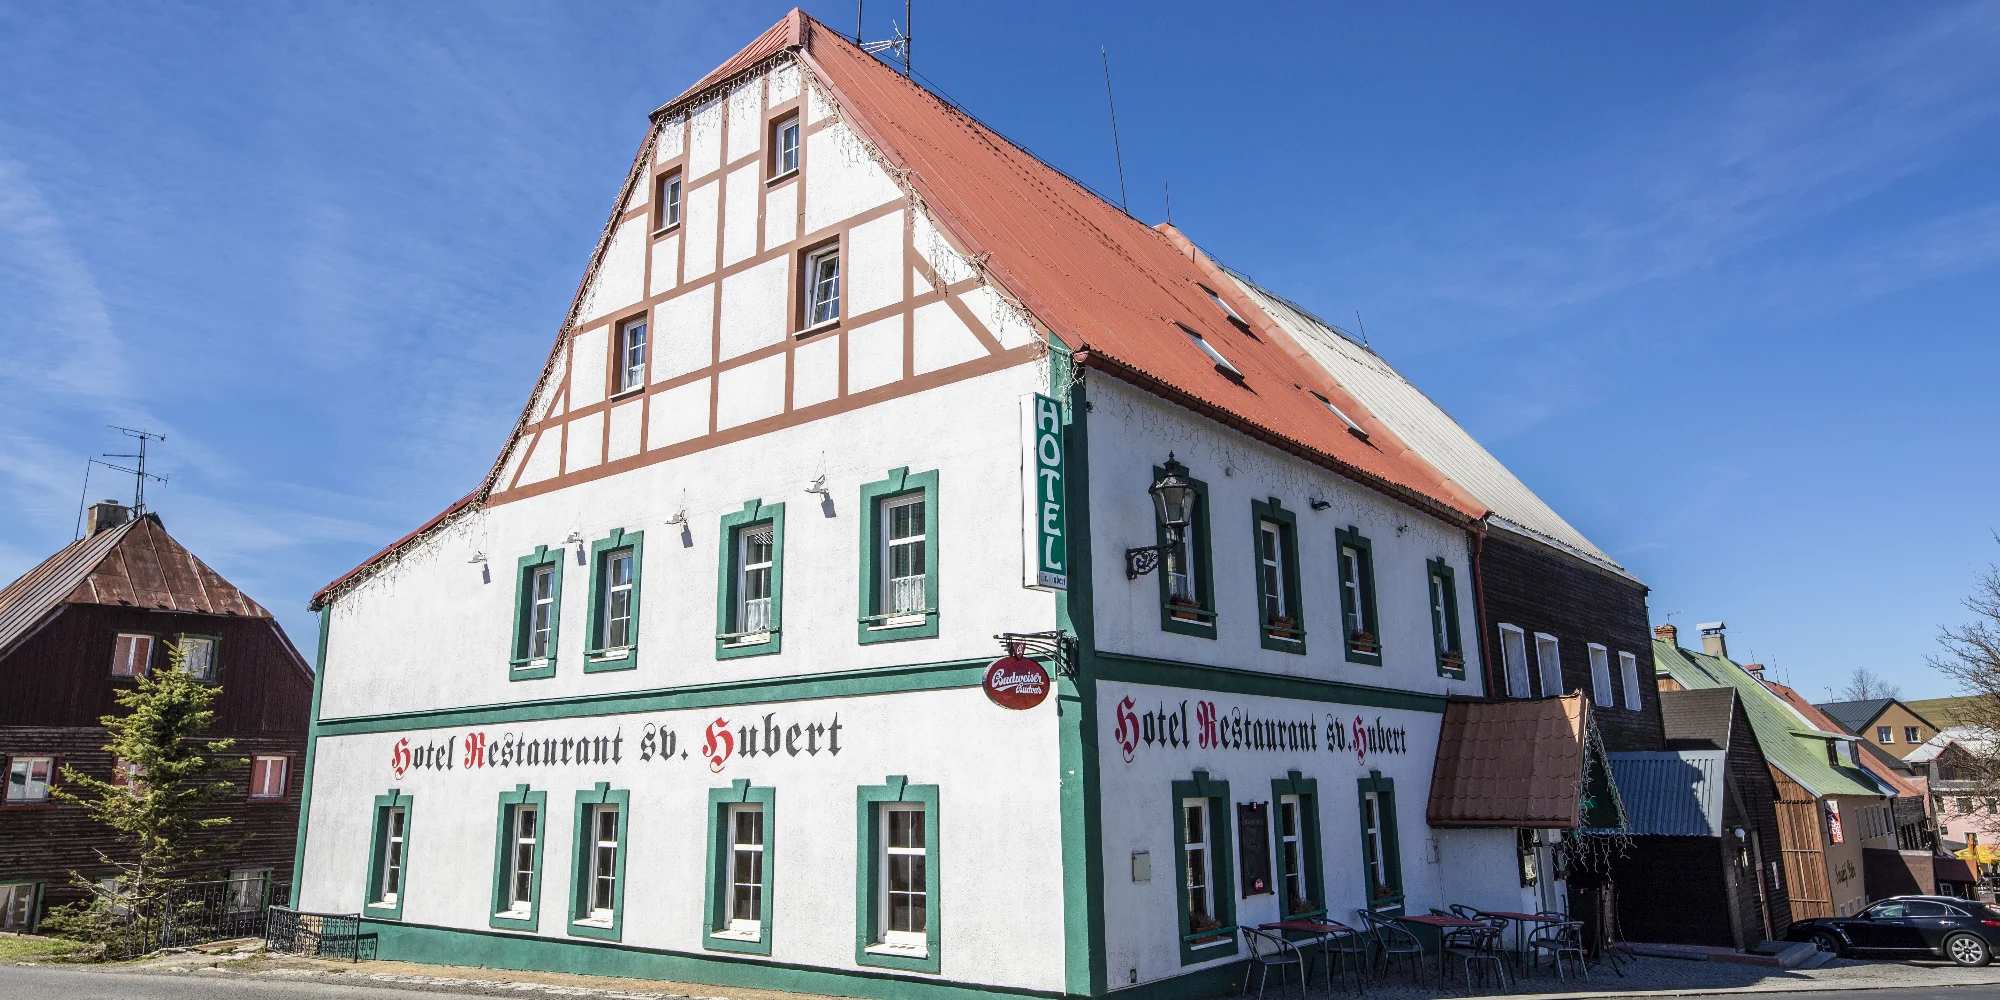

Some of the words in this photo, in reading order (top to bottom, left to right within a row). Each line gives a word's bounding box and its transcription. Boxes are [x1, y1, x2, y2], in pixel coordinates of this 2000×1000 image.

[1037, 398, 1062, 571] HOTEL
[991, 668, 1044, 689] Budweiser
[391, 735, 457, 781] Hotel
[463, 726, 624, 770] Restaurant
[639, 722, 689, 763] sv.
[702, 711, 843, 774] Hubert
[1114, 695, 1191, 764] Hotel
[1196, 699, 1318, 752] Restaurant
[1353, 714, 1407, 766] Hubert
